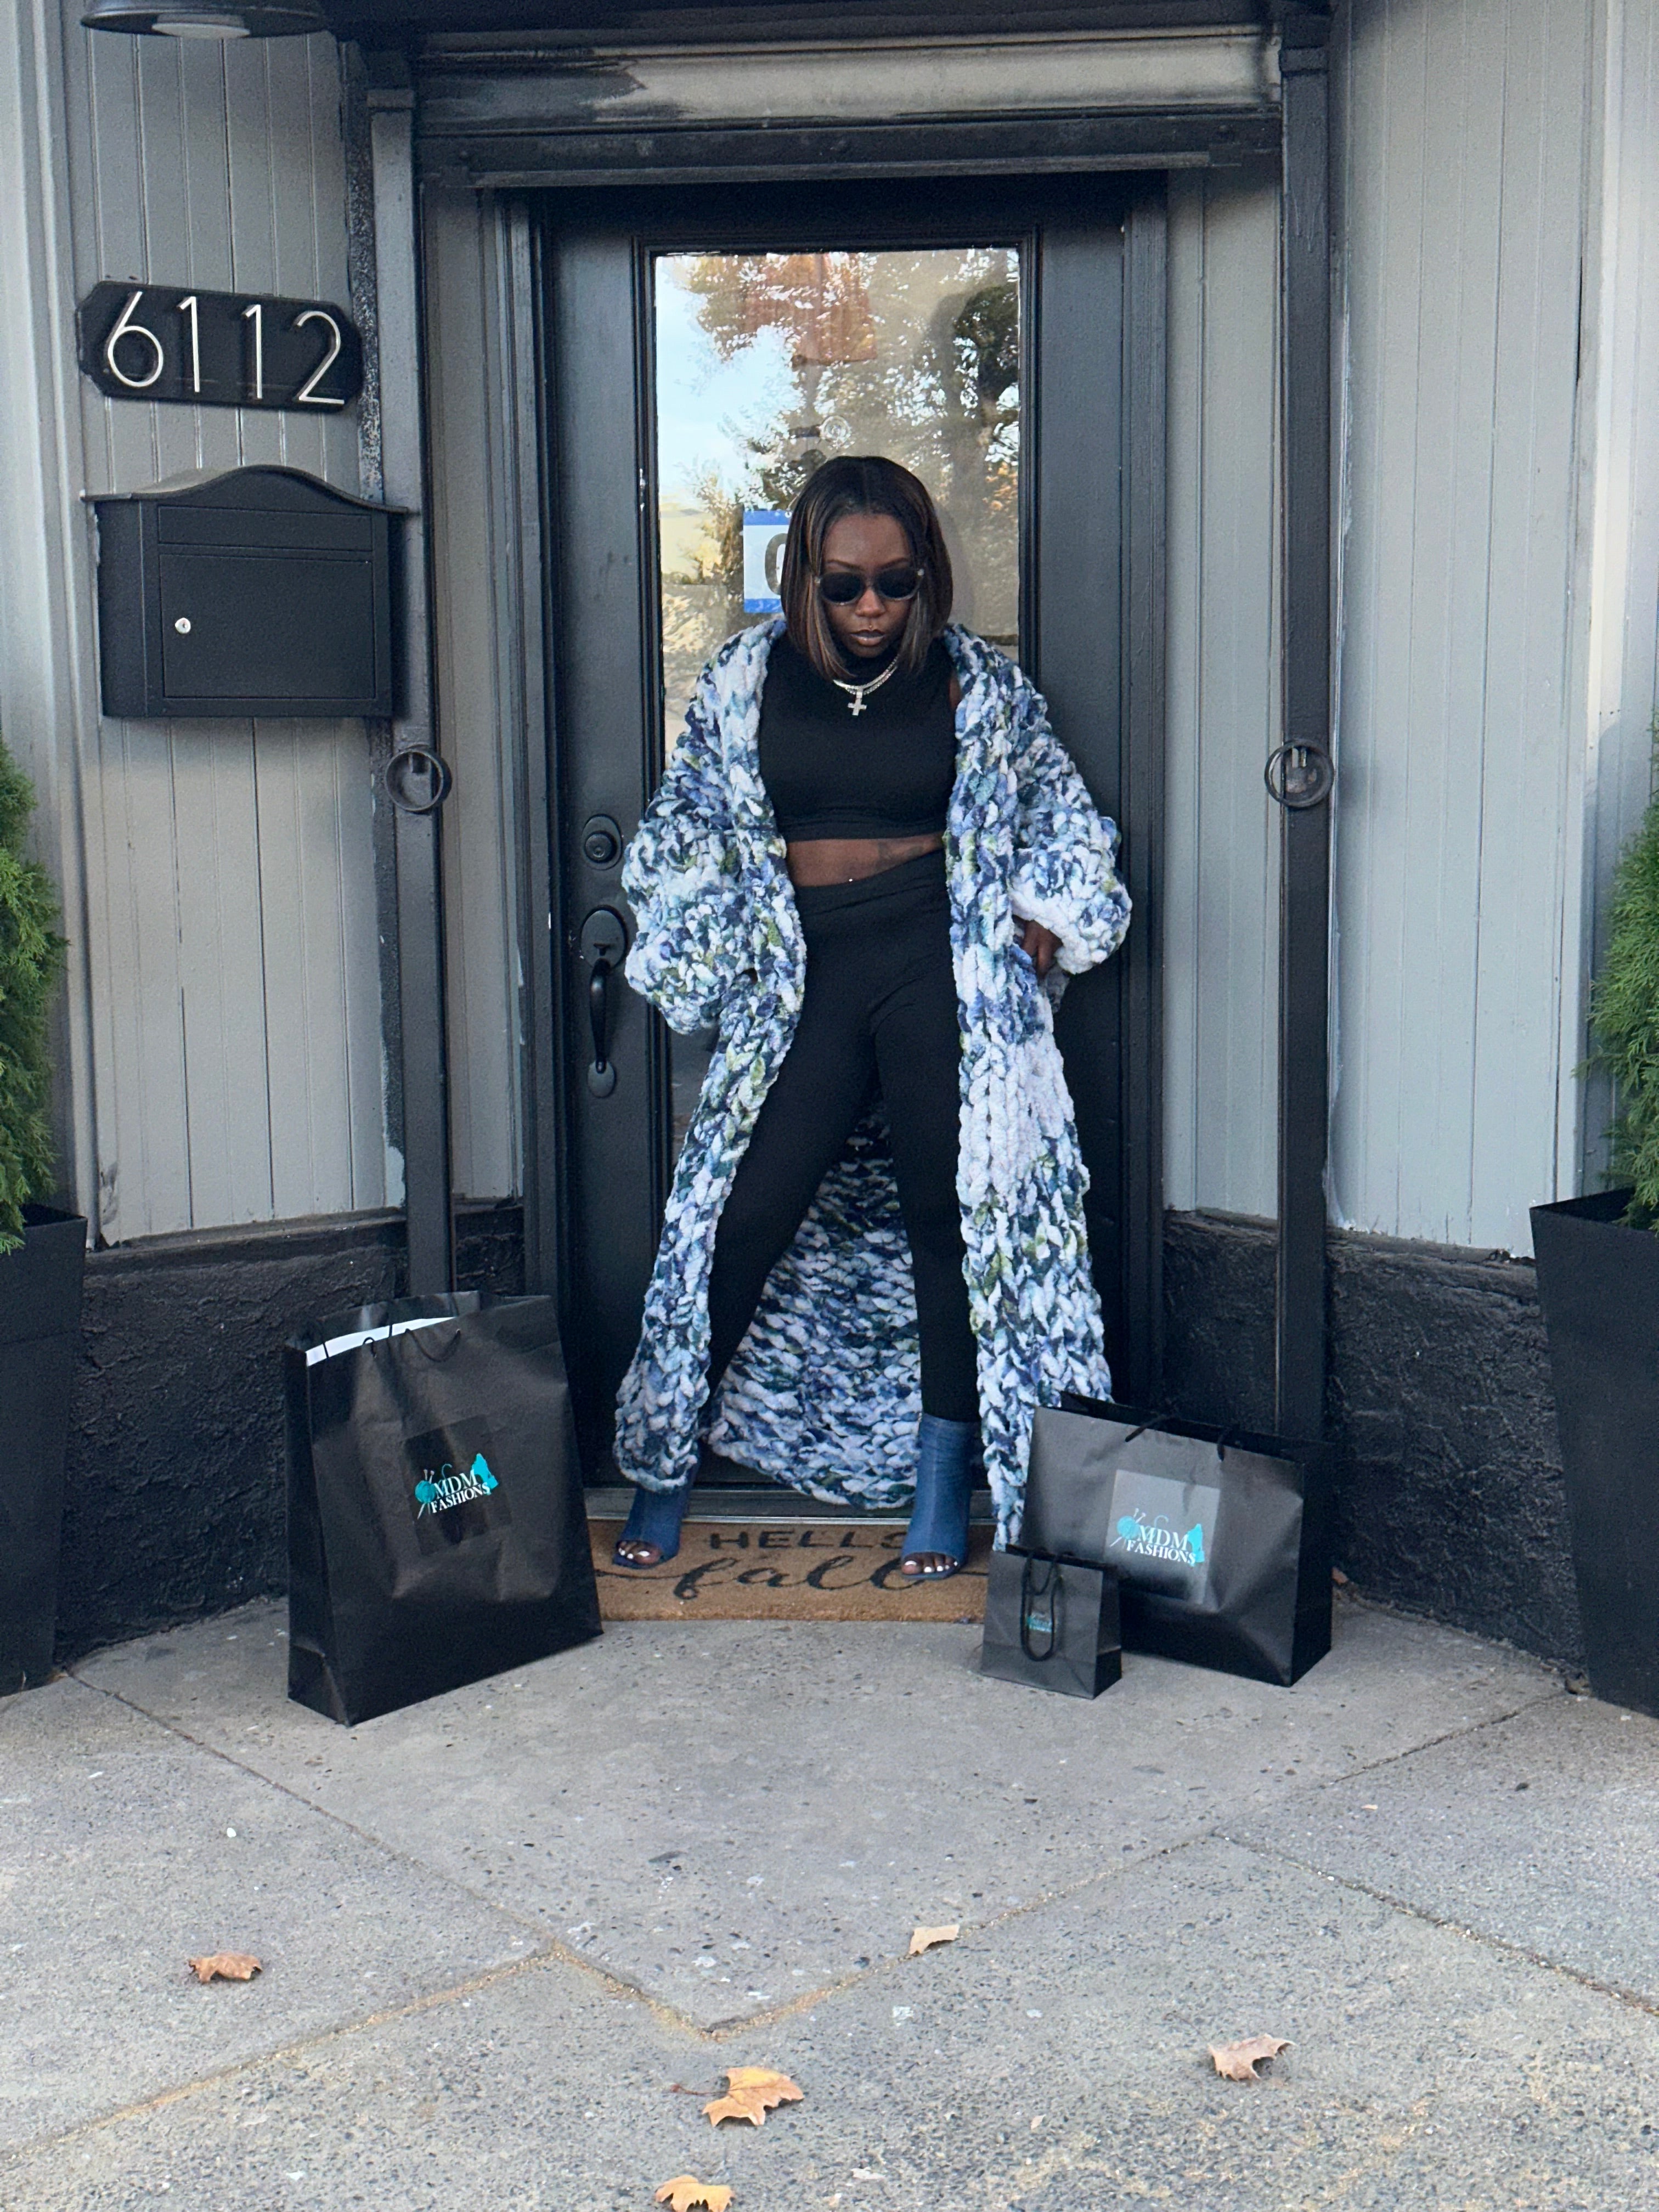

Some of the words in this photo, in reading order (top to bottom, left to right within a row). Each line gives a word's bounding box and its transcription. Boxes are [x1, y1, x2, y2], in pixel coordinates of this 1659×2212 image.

[107, 291, 345, 404] 6112
[430, 1482, 492, 1514] FASHIONS
[433, 1469, 478, 1499] MDM
[1126, 1539, 1196, 1567] FASHIONS
[1137, 1525, 1189, 1551] MDM
